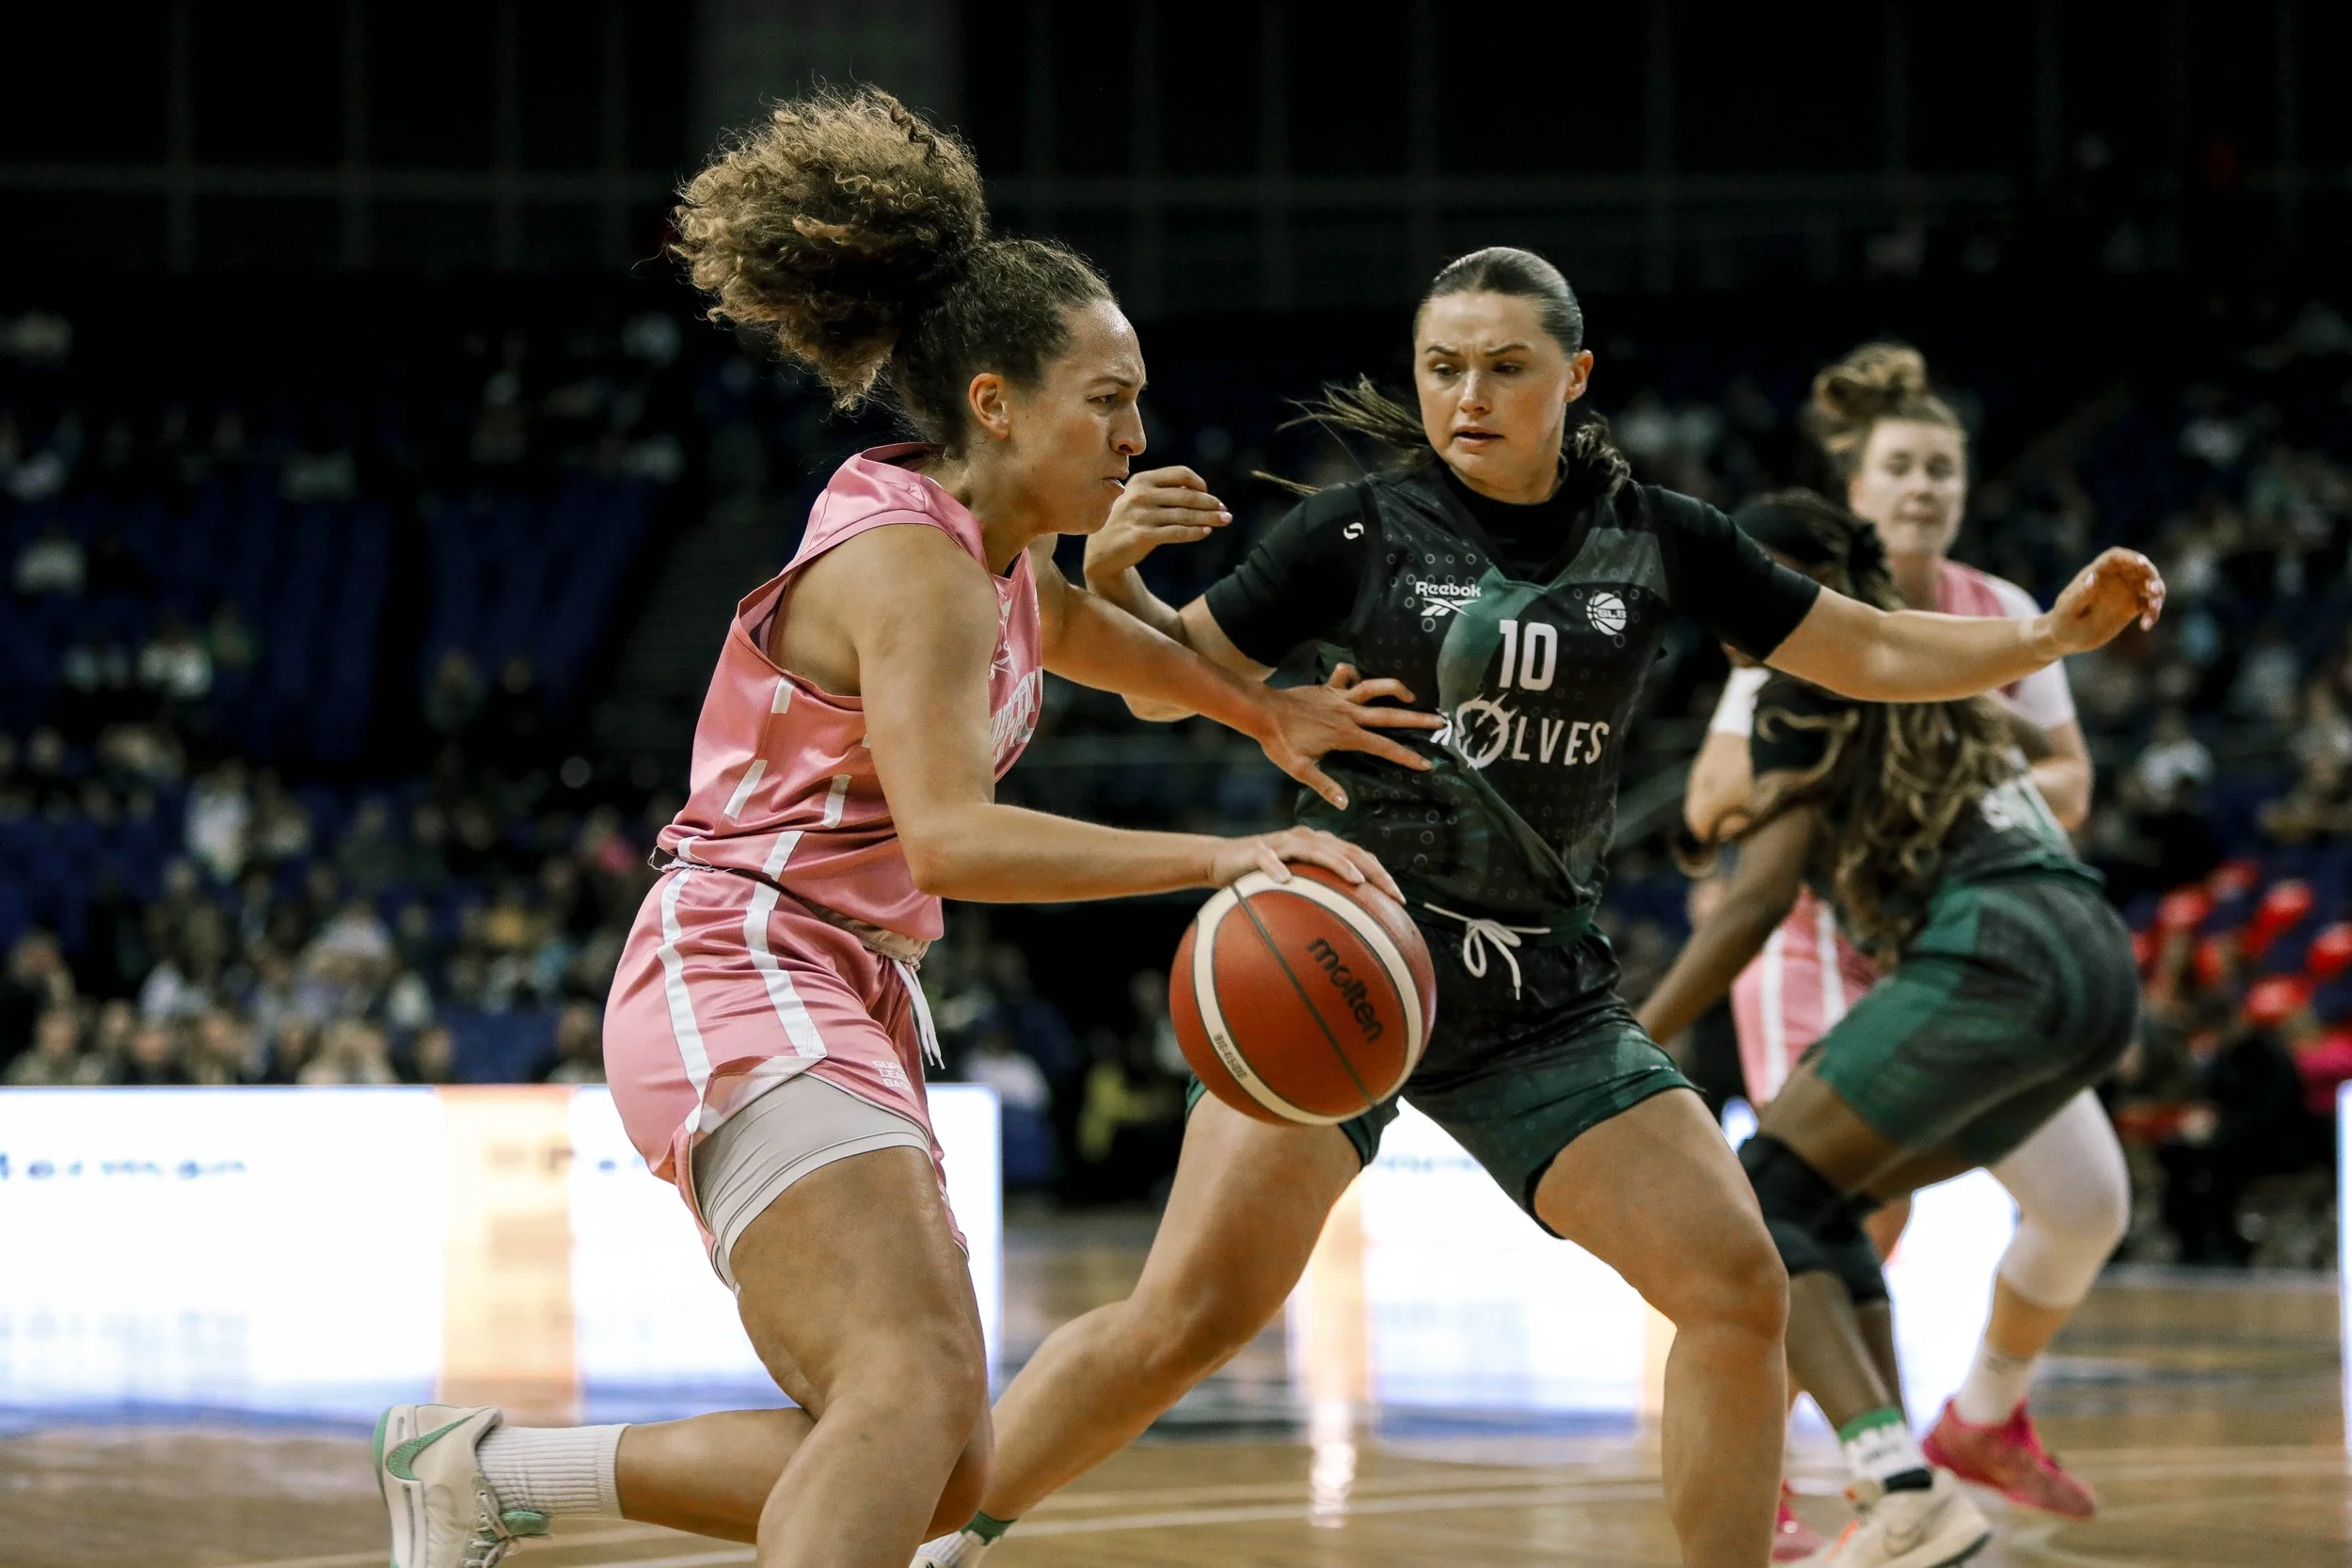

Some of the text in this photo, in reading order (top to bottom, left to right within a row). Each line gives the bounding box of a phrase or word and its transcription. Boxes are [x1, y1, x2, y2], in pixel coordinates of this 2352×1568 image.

[1415, 581, 1482, 597] Reebok
[1499, 619, 1558, 691] 10
[1309, 939, 1383, 1043] molten
